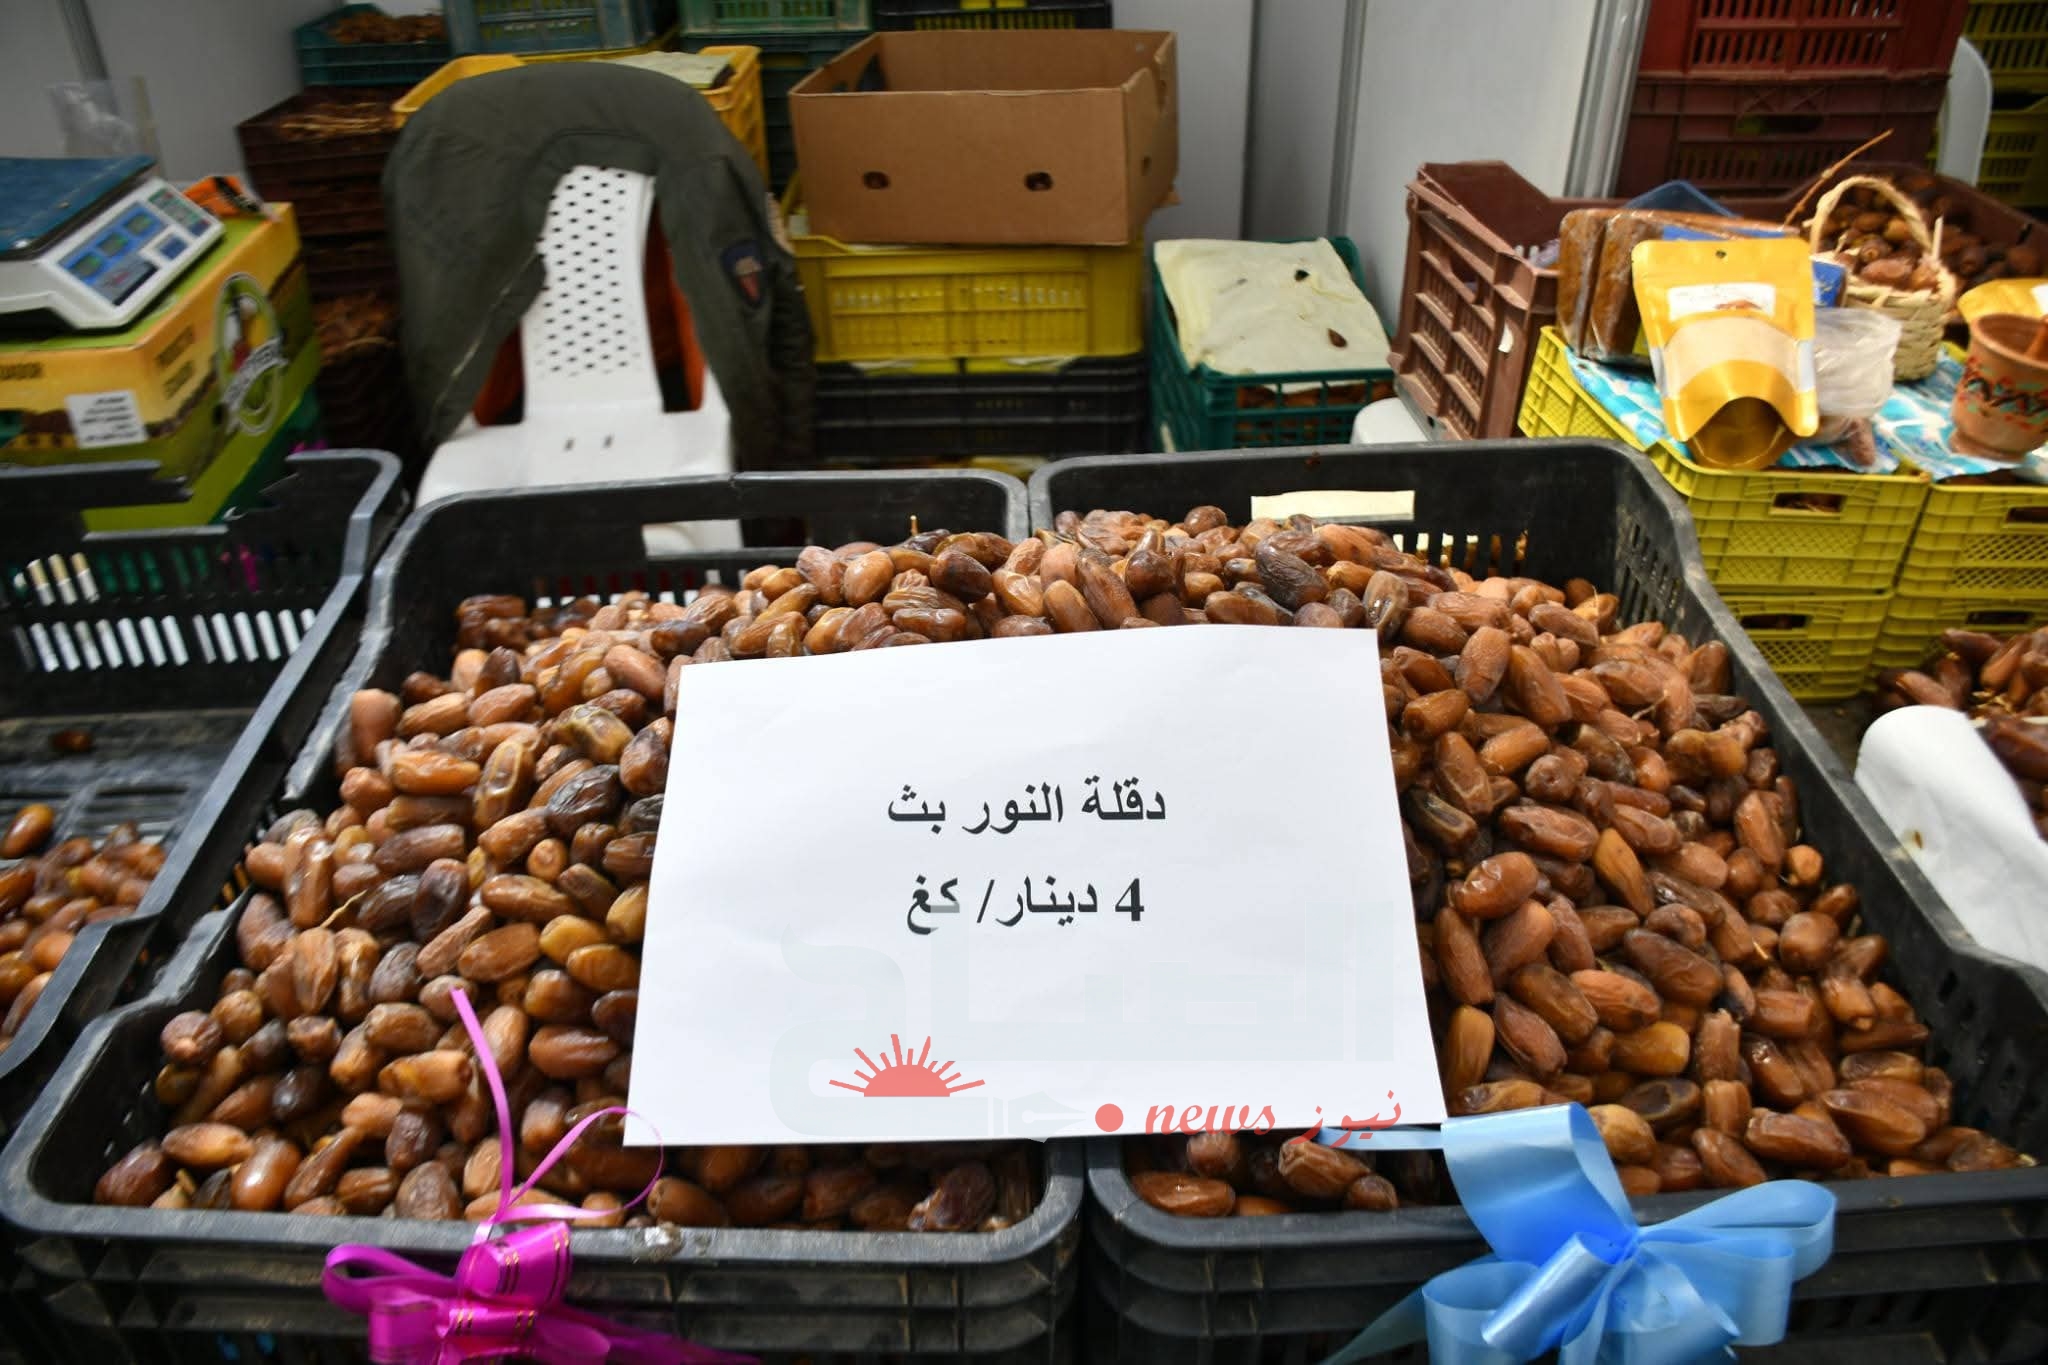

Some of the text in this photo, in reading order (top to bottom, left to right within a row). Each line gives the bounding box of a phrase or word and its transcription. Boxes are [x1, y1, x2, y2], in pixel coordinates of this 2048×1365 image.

[887, 774, 1166, 835] دقلة النور بث
[906, 874, 961, 936] كغ
[1114, 877, 1145, 922] 4
